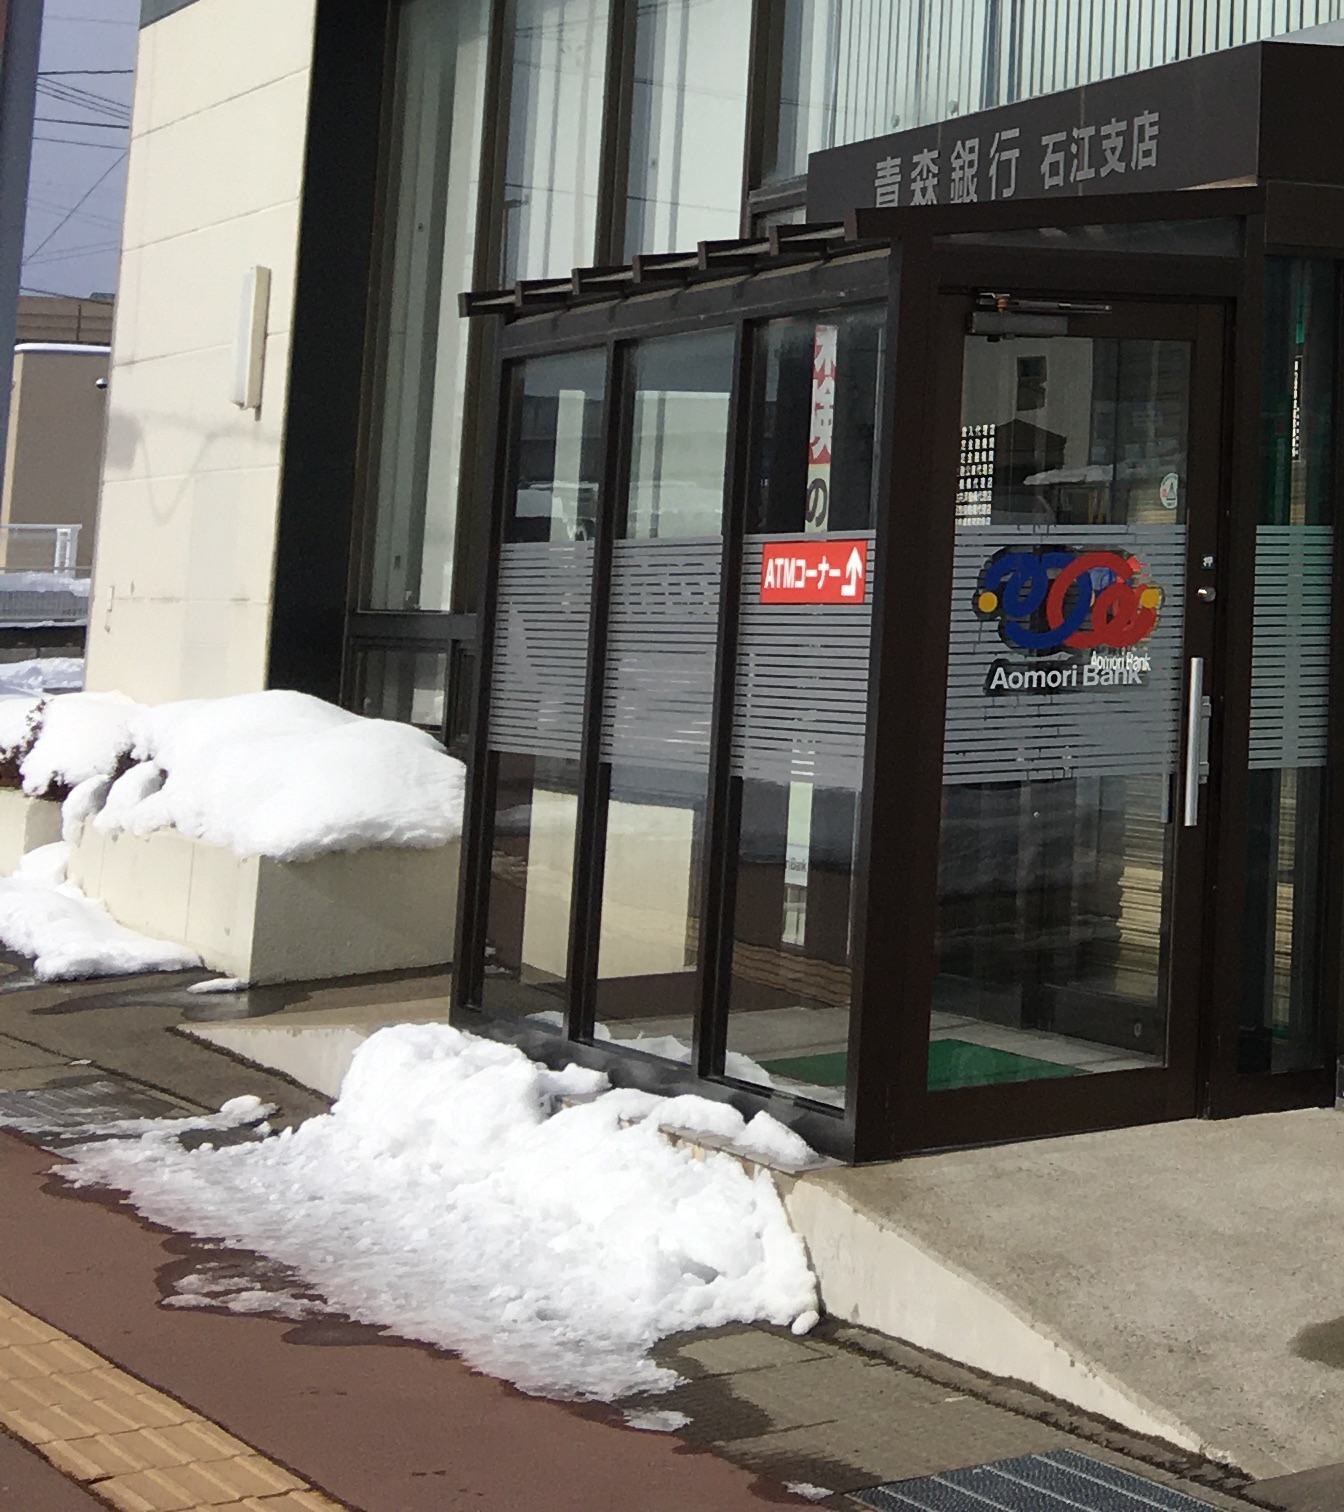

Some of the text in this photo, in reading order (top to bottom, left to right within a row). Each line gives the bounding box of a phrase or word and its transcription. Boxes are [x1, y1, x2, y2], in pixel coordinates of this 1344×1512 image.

[874, 110, 1161, 208] 青森銀行 石江支店
[763, 555, 841, 590] ATMコーナー
[989, 664, 1143, 690] Aomori Bank
